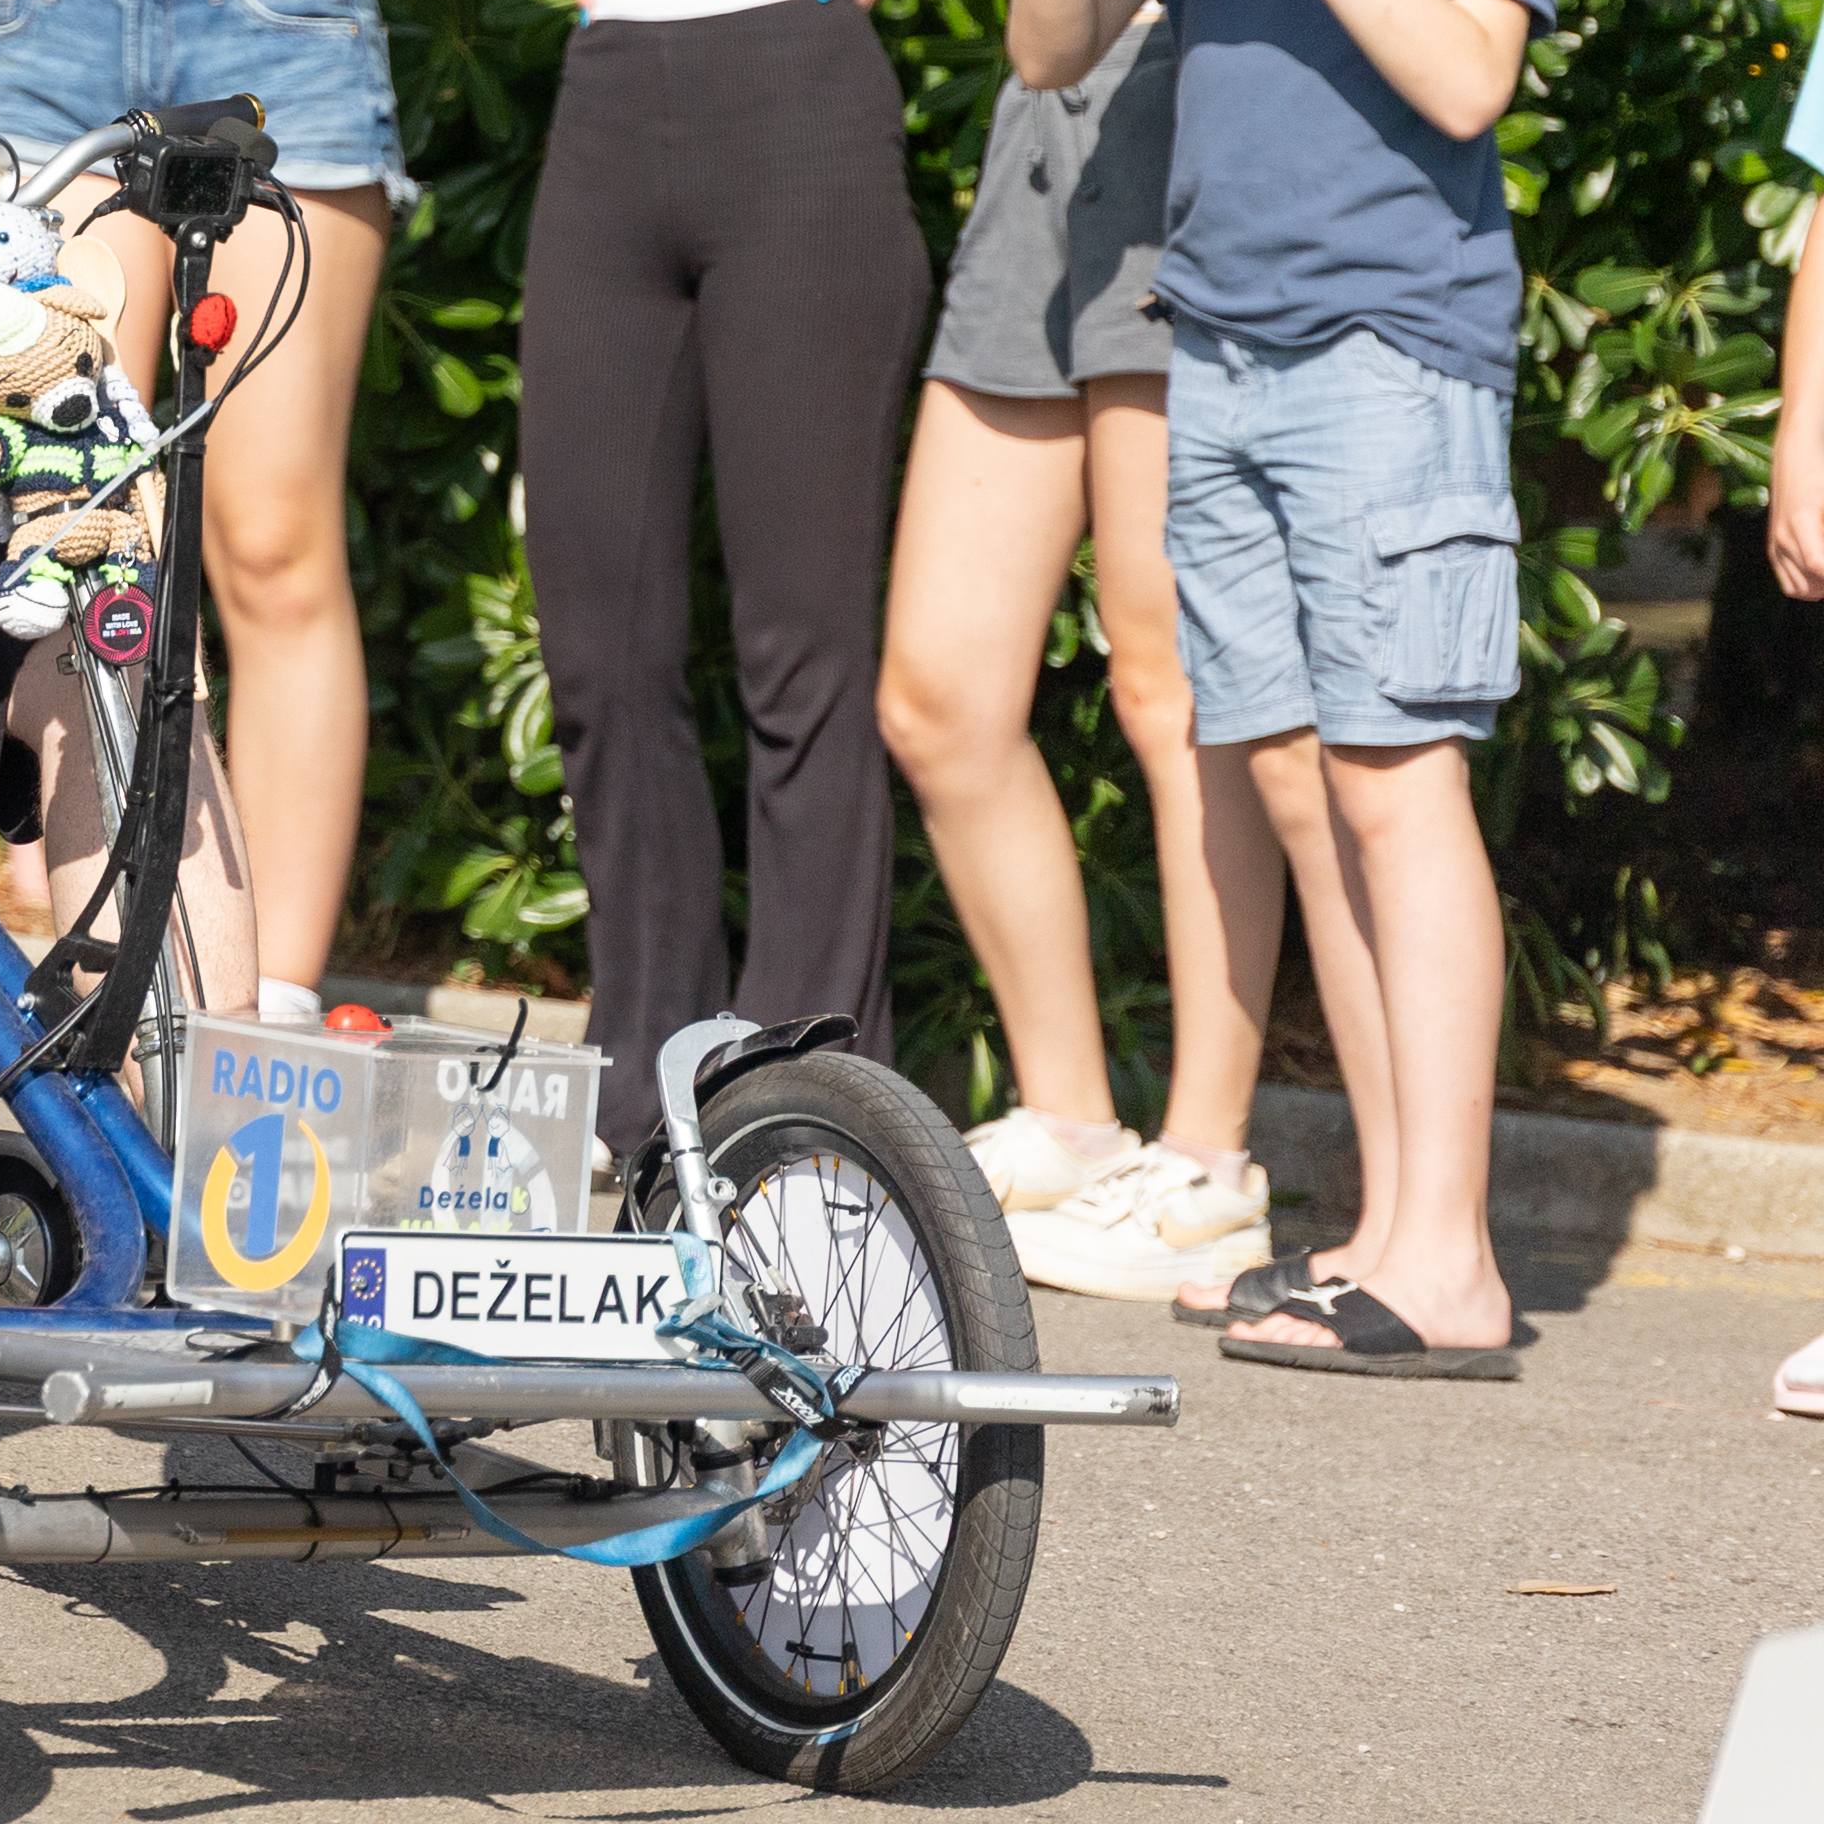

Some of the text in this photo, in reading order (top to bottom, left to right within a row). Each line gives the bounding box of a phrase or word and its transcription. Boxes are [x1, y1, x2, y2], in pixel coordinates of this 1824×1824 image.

[212, 1048, 342, 1114] RADIO
[412, 1259, 670, 1325] DEŽELAK
[771, 1386, 825, 1427] TRAX
[832, 1365, 865, 1396] TRAX
